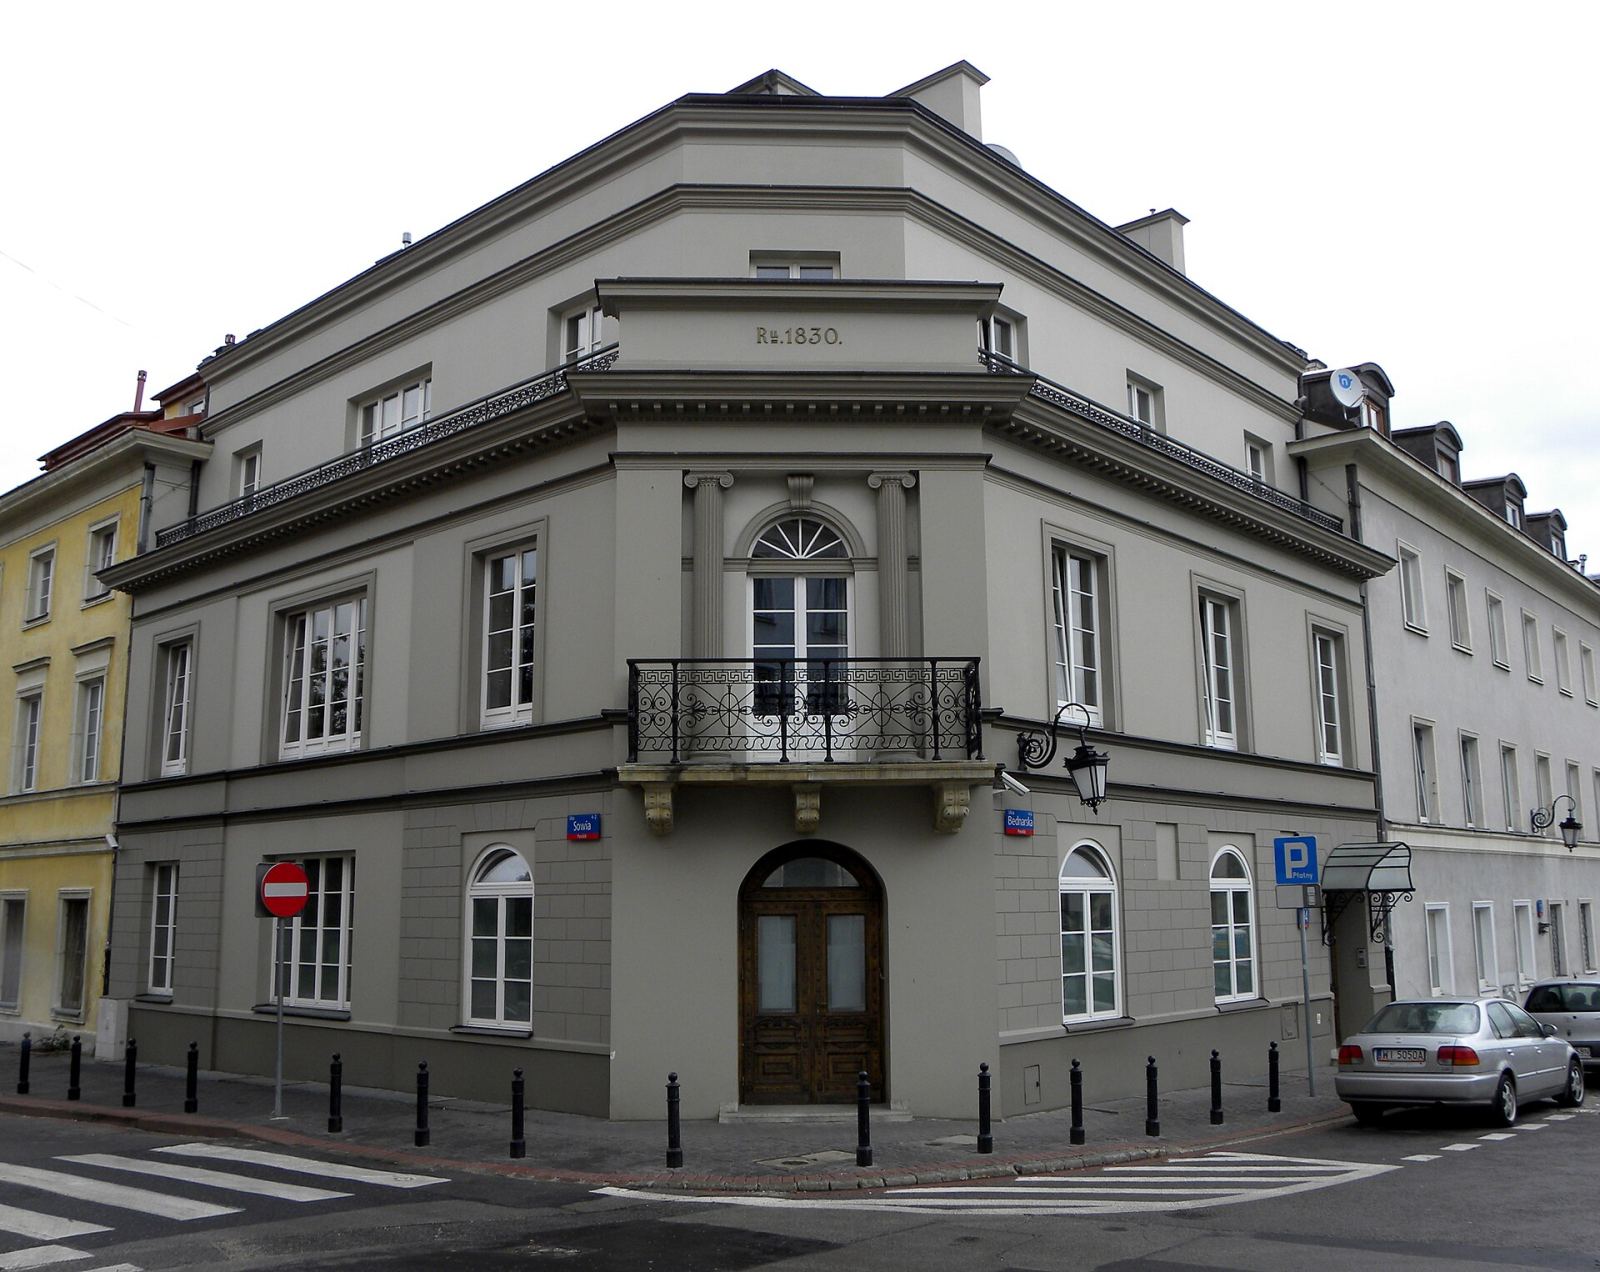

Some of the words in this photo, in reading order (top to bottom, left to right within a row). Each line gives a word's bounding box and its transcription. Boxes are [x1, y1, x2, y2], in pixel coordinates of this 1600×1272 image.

[573, 820, 592, 832] Sowia
[1007, 815, 1033, 827] Bednarska
[1283, 842, 1309, 879] P
